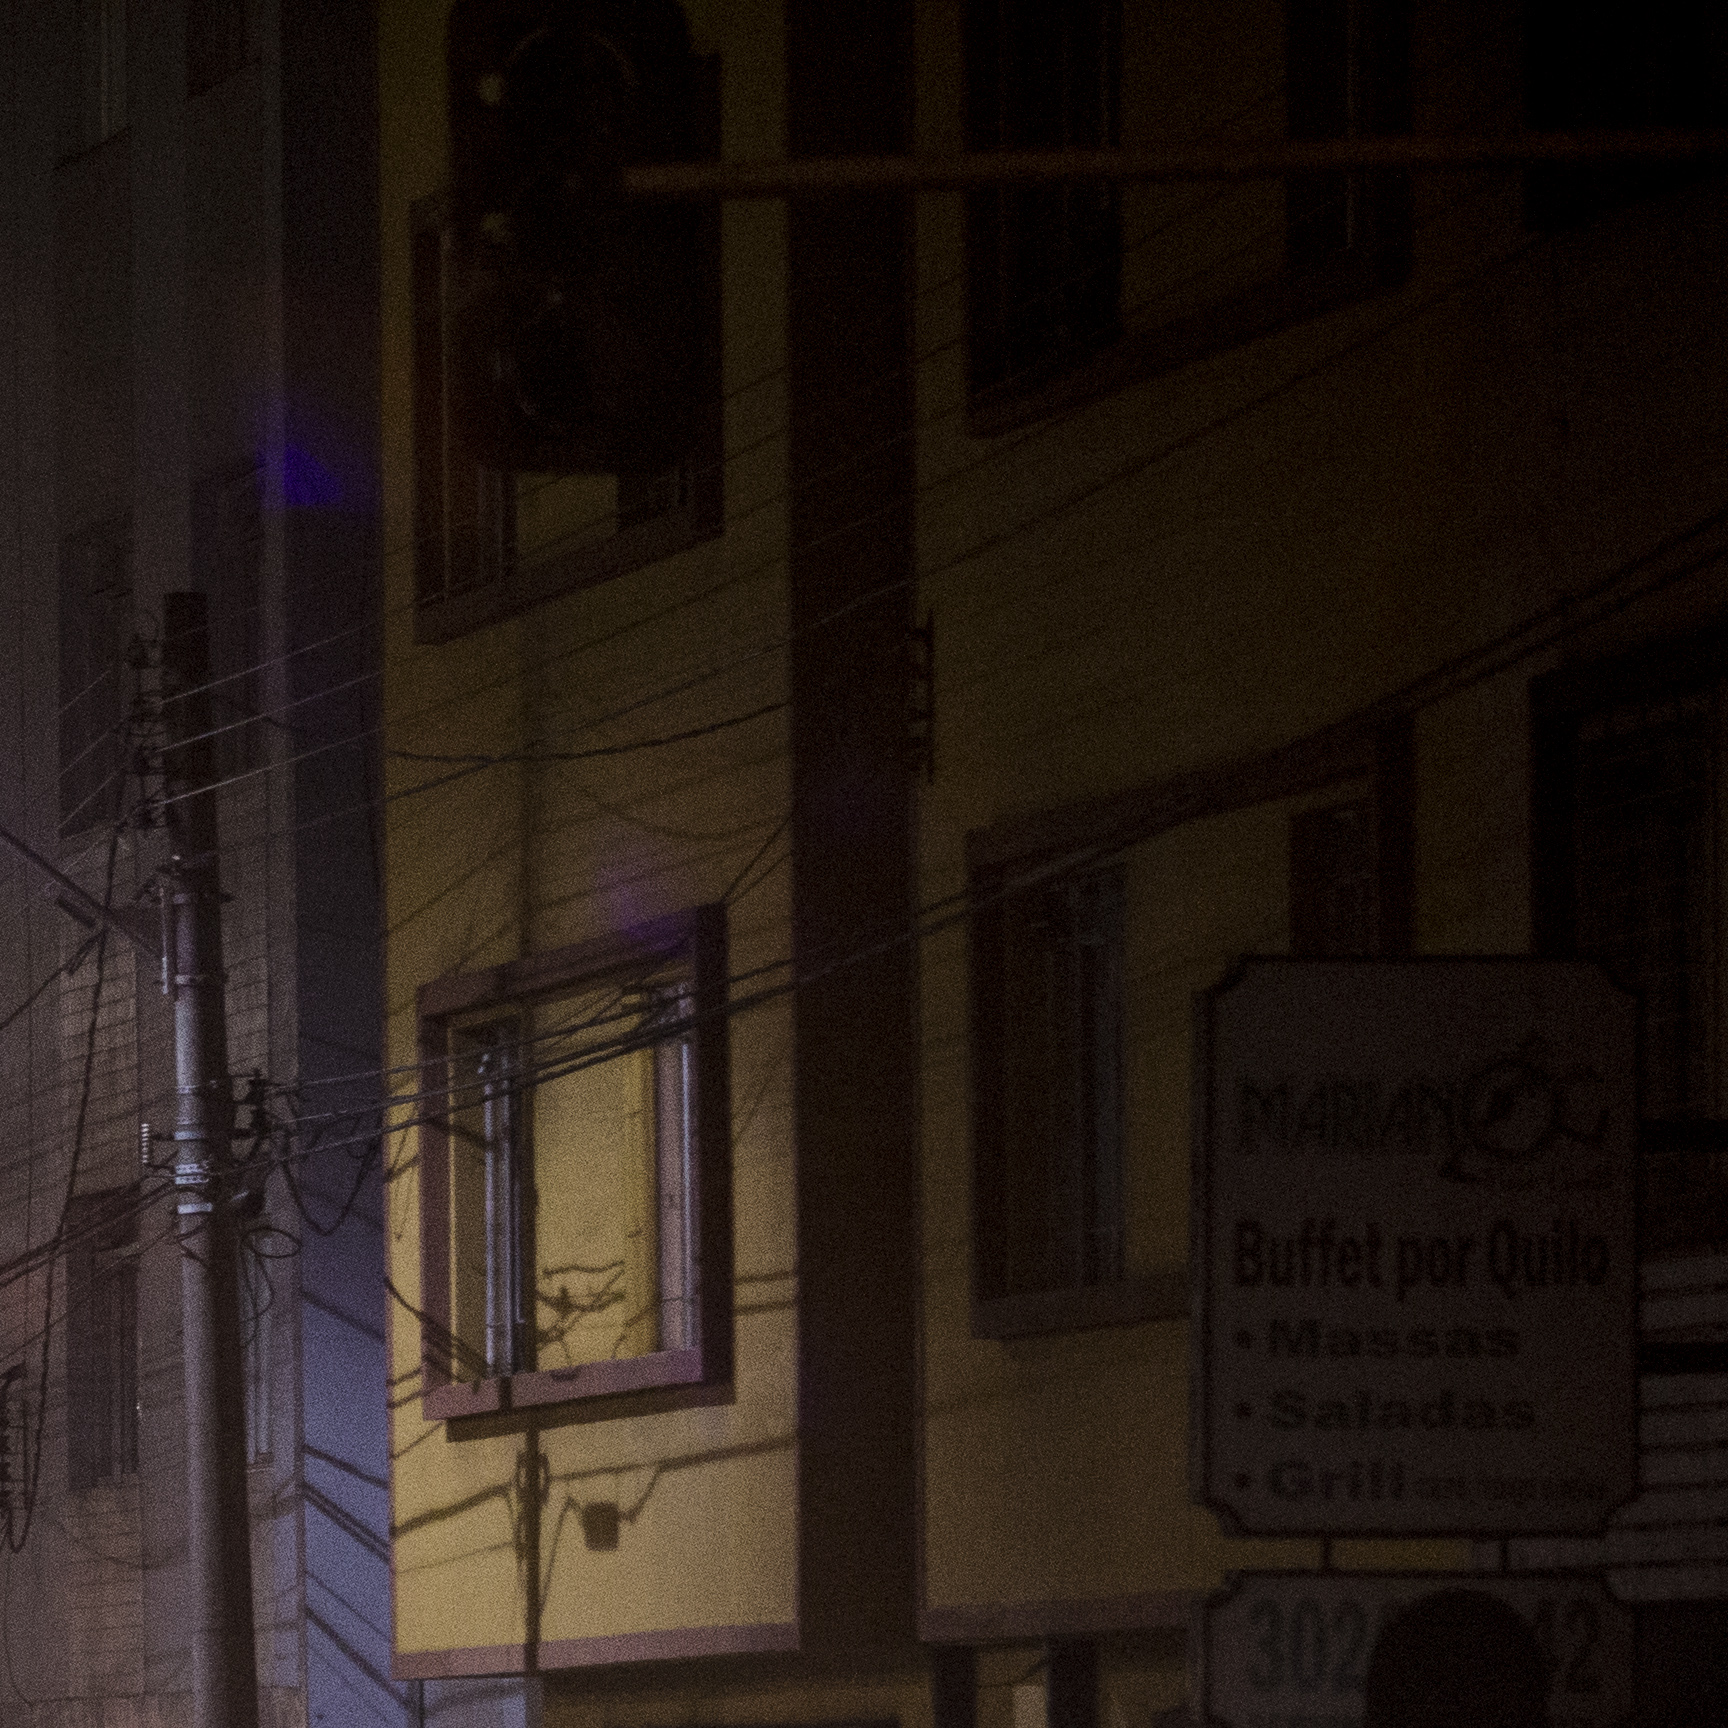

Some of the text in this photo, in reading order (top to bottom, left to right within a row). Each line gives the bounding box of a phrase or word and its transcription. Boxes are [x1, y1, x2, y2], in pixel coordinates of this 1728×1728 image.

[1233, 1217, 1609, 1302] Buffet por Quilo
[1267, 1319, 1522, 1358] Massas
[1267, 1389, 1537, 1431] Saladas
[1267, 1458, 1407, 1500] Grill
